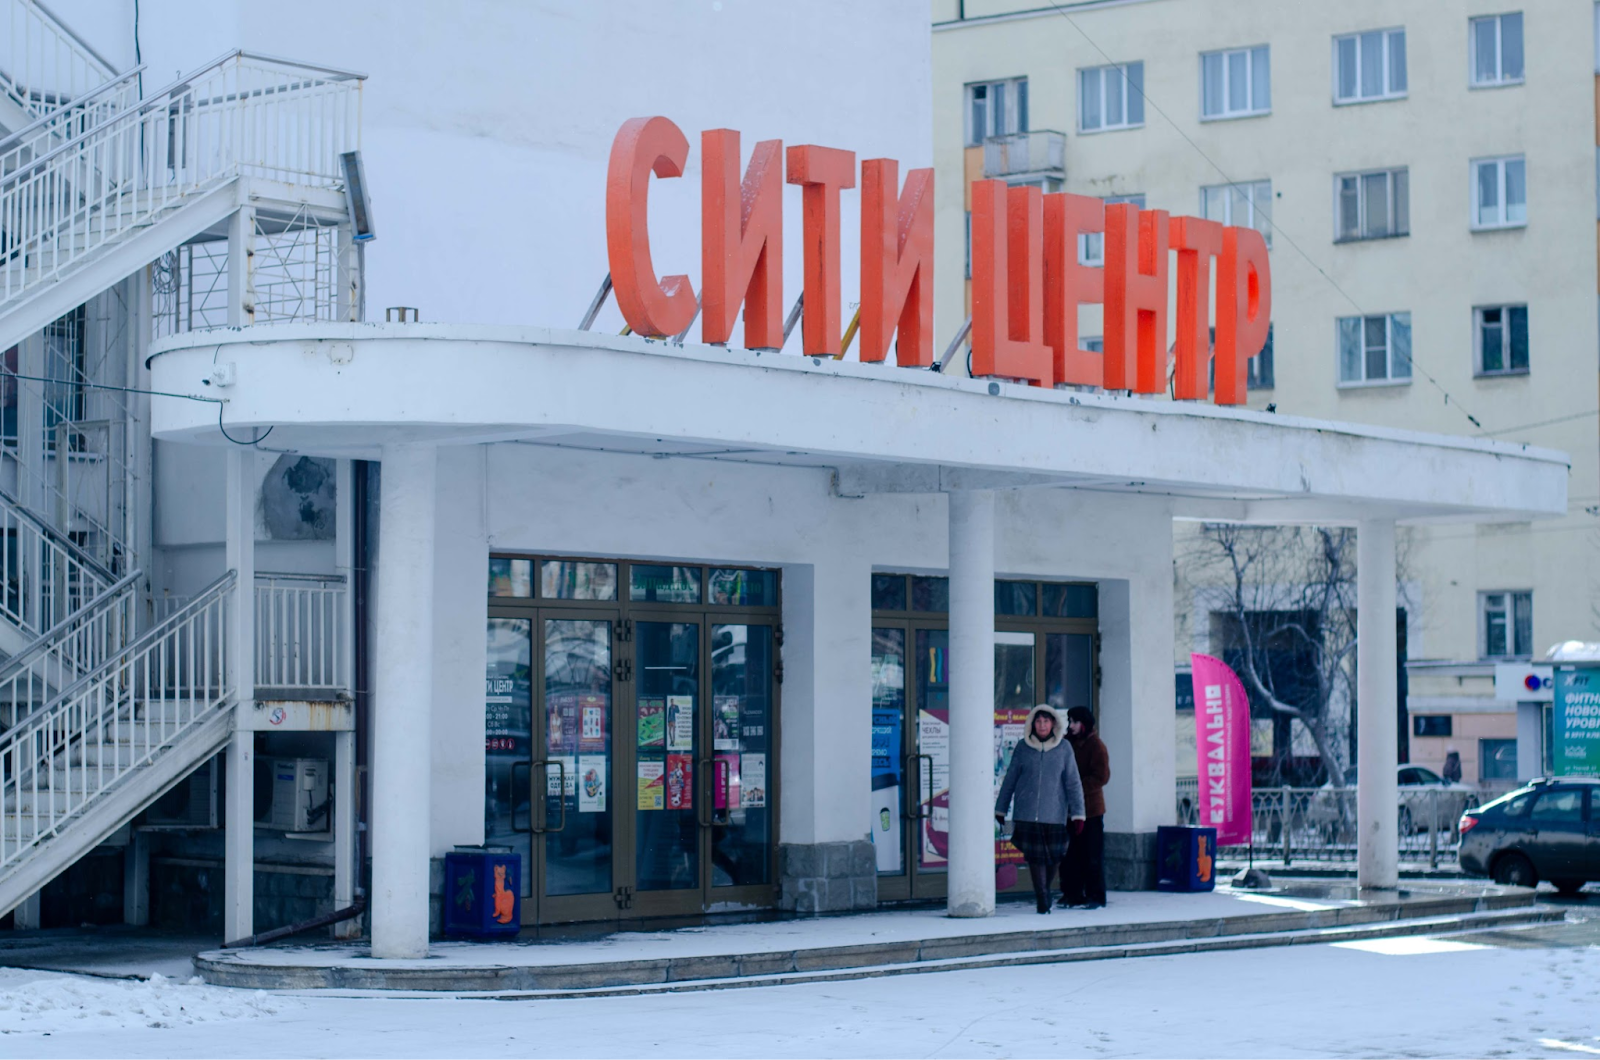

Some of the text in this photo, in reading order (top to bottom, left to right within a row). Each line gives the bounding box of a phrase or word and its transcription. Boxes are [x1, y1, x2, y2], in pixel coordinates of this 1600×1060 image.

[605, 115, 1272, 405] СИТИ ЦЕНТР
[494, 681, 513, 694] ЦЕНТР
[1205, 684, 1225, 823] БУКВАЛЬНО
